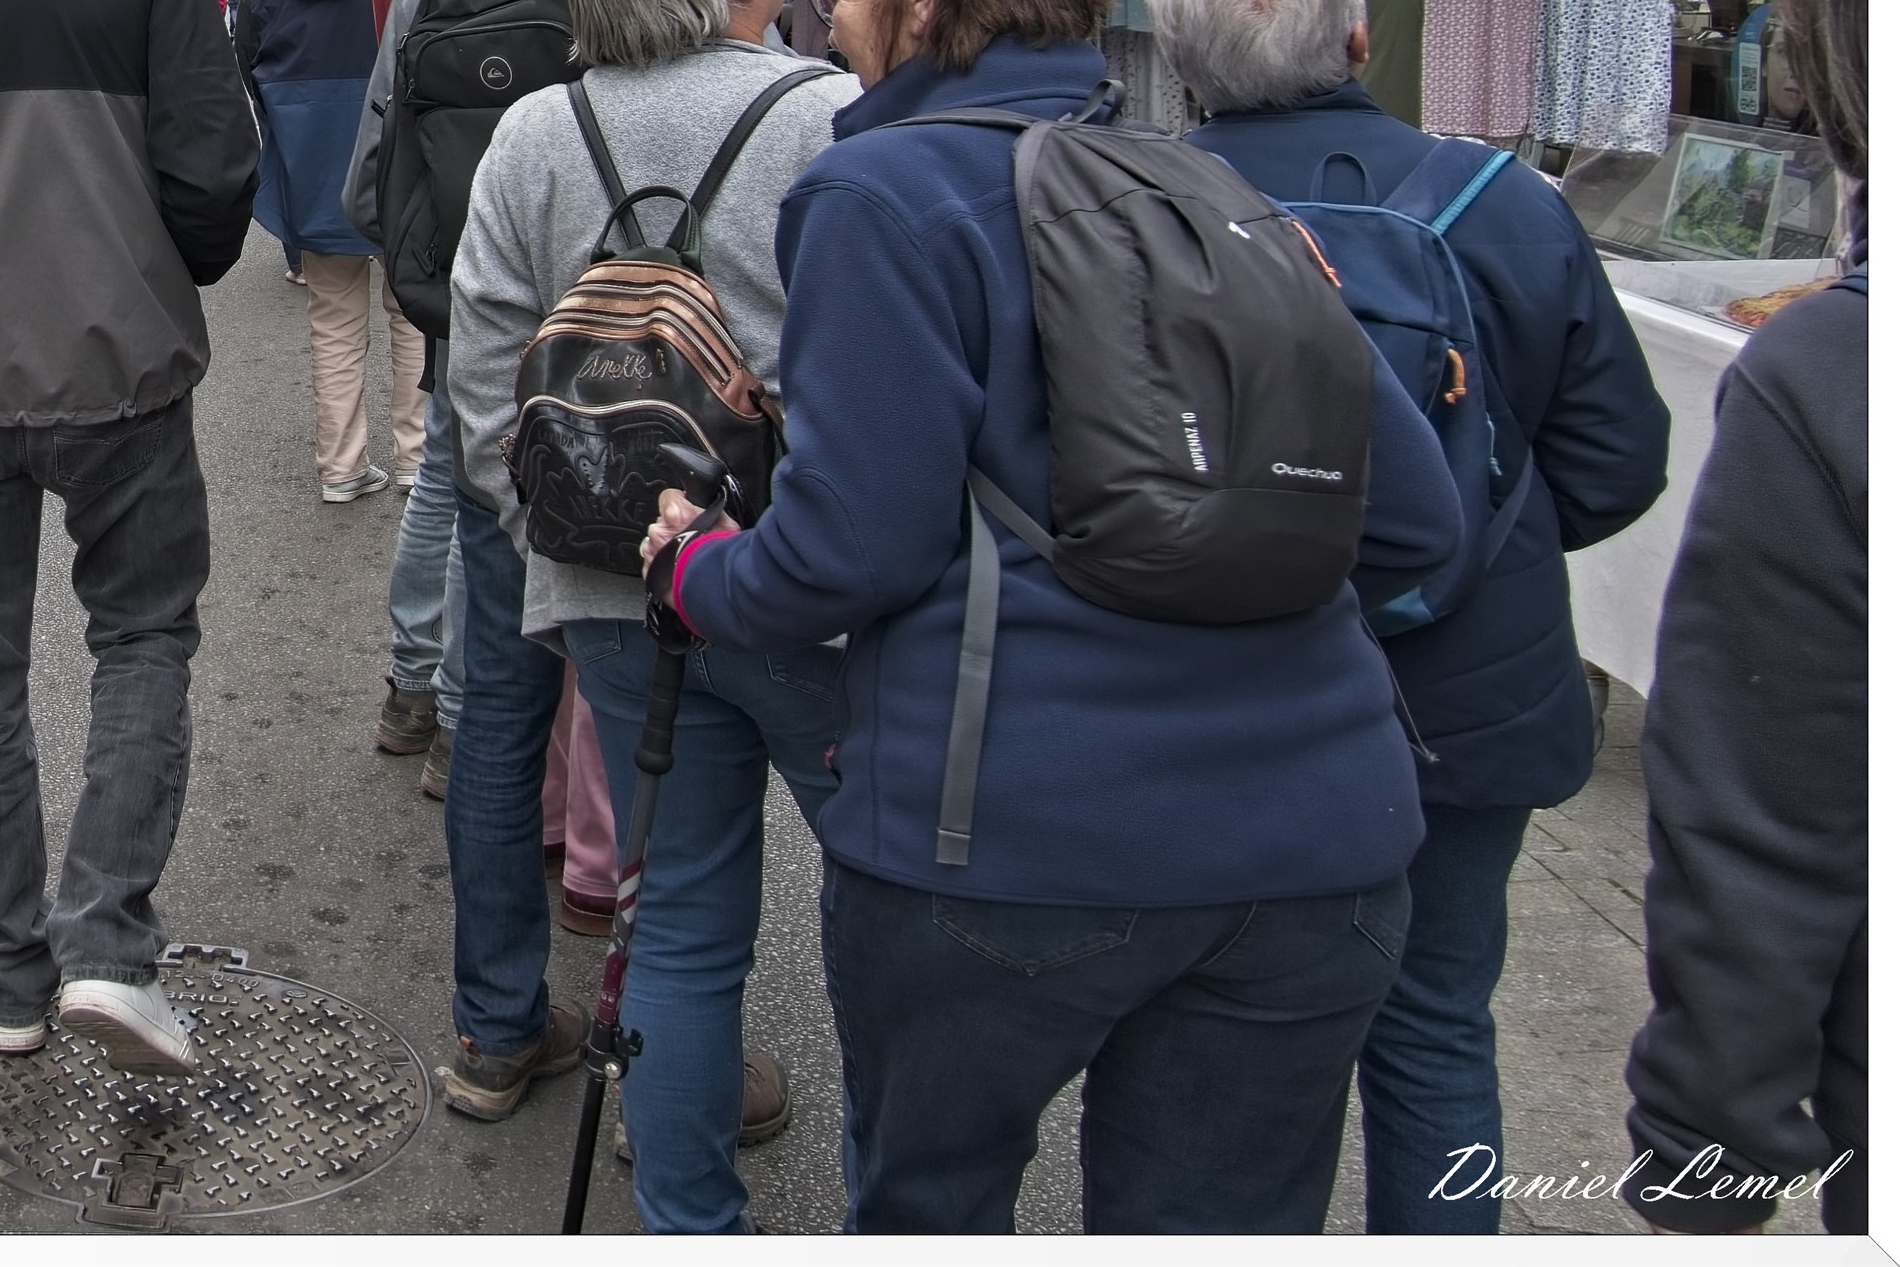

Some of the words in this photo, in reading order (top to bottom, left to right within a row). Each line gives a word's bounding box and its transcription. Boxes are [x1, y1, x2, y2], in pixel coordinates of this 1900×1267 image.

[1181, 412, 1198, 423] 10
[1184, 426, 1209, 473] ARPENAZ
[1271, 462, 1343, 481] Quechua
